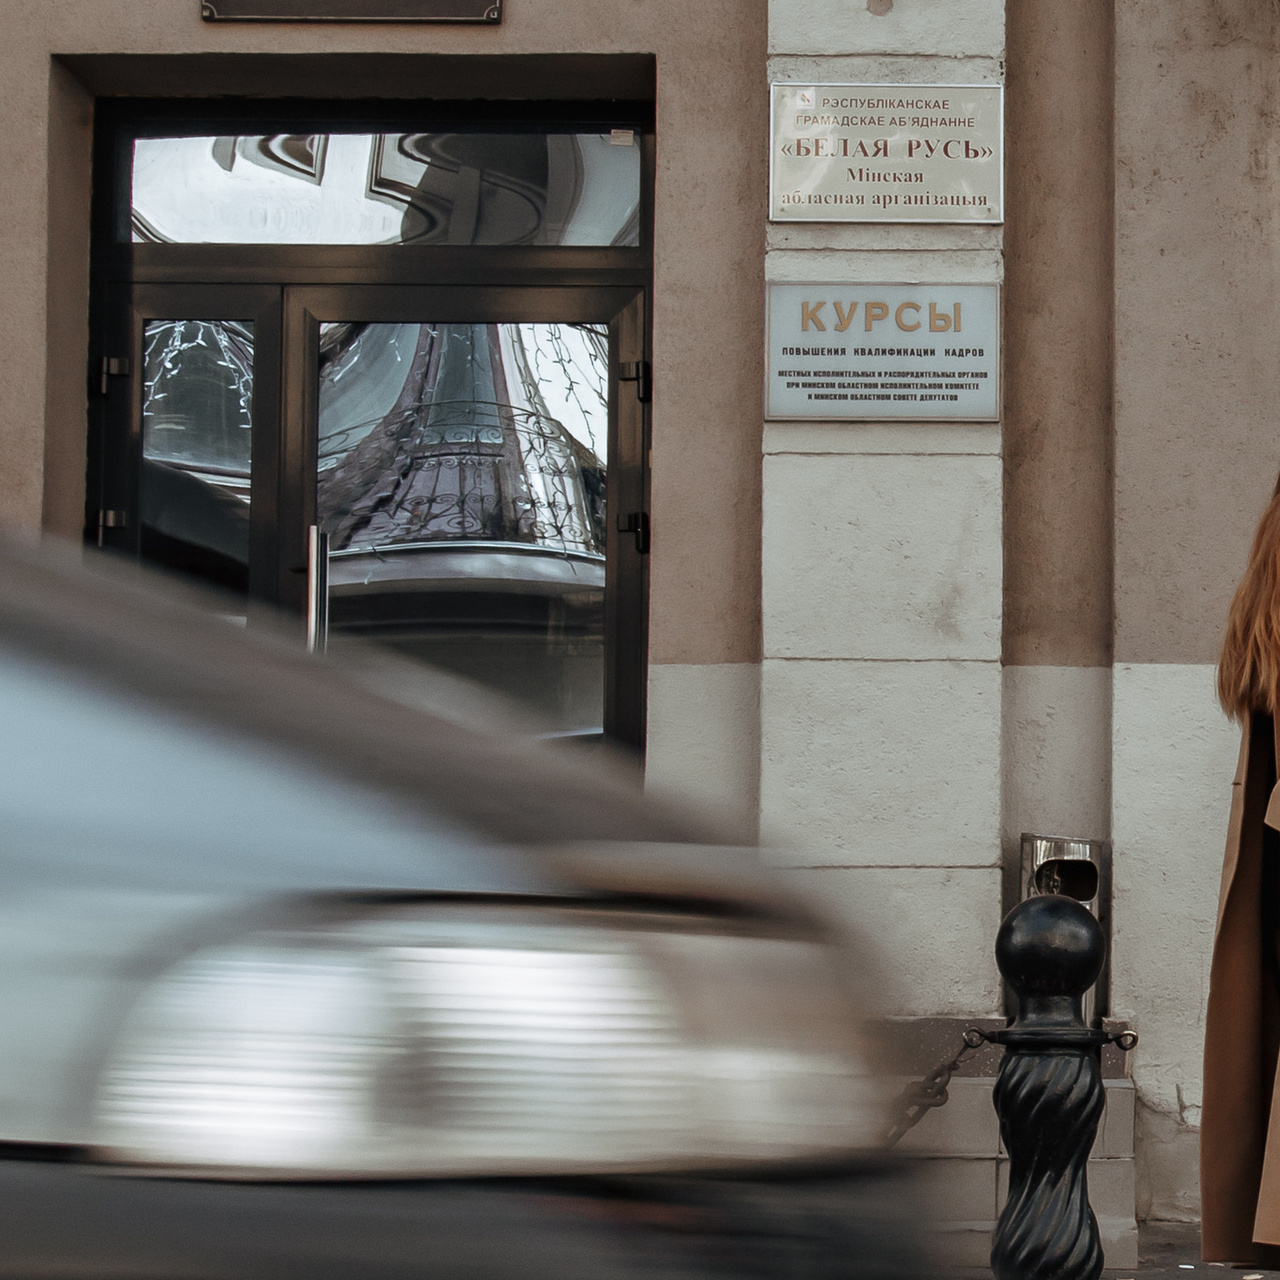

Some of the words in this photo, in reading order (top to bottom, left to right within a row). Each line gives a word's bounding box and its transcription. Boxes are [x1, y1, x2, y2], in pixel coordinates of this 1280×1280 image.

[822, 98, 950, 110] РЭСПУБЛІКАНСКАЕ
[796, 115, 886, 128] ГРАМАДСКАЕ
[780, 137, 890, 158] «БЕЛАЯ
[907, 139, 994, 160] РУСЬ»
[846, 167, 924, 183] Мінская
[781, 190, 865, 205] абласная
[872, 191, 988, 209] арганізацыя
[800, 300, 962, 333] КУРСЫ
[782, 347, 846, 356] ПОВЫШЕНИЯ
[853, 347, 936, 358] КВАЛИФИКАЦИИ
[944, 348, 985, 358] КАДРОВ
[813, 370, 876, 378] ИСПОЛНИТЕЛЬНЫХ
[883, 371, 956, 379] РАСПОРЯДИТЕЛЬНЫХ
[957, 371, 988, 379] ОРГАНОВ
[786, 381, 800, 389] ПРИ
[880, 382, 943, 390] ИСПОЛНИТЕЛЬНОМ
[814, 393, 849, 401] МИНСКОМ
[850, 393, 891, 401] ОБЛАСТНОМ
[893, 393, 918, 401] СОВЕТЕ
[919, 394, 959, 402] ДЕПУТАТОВ
